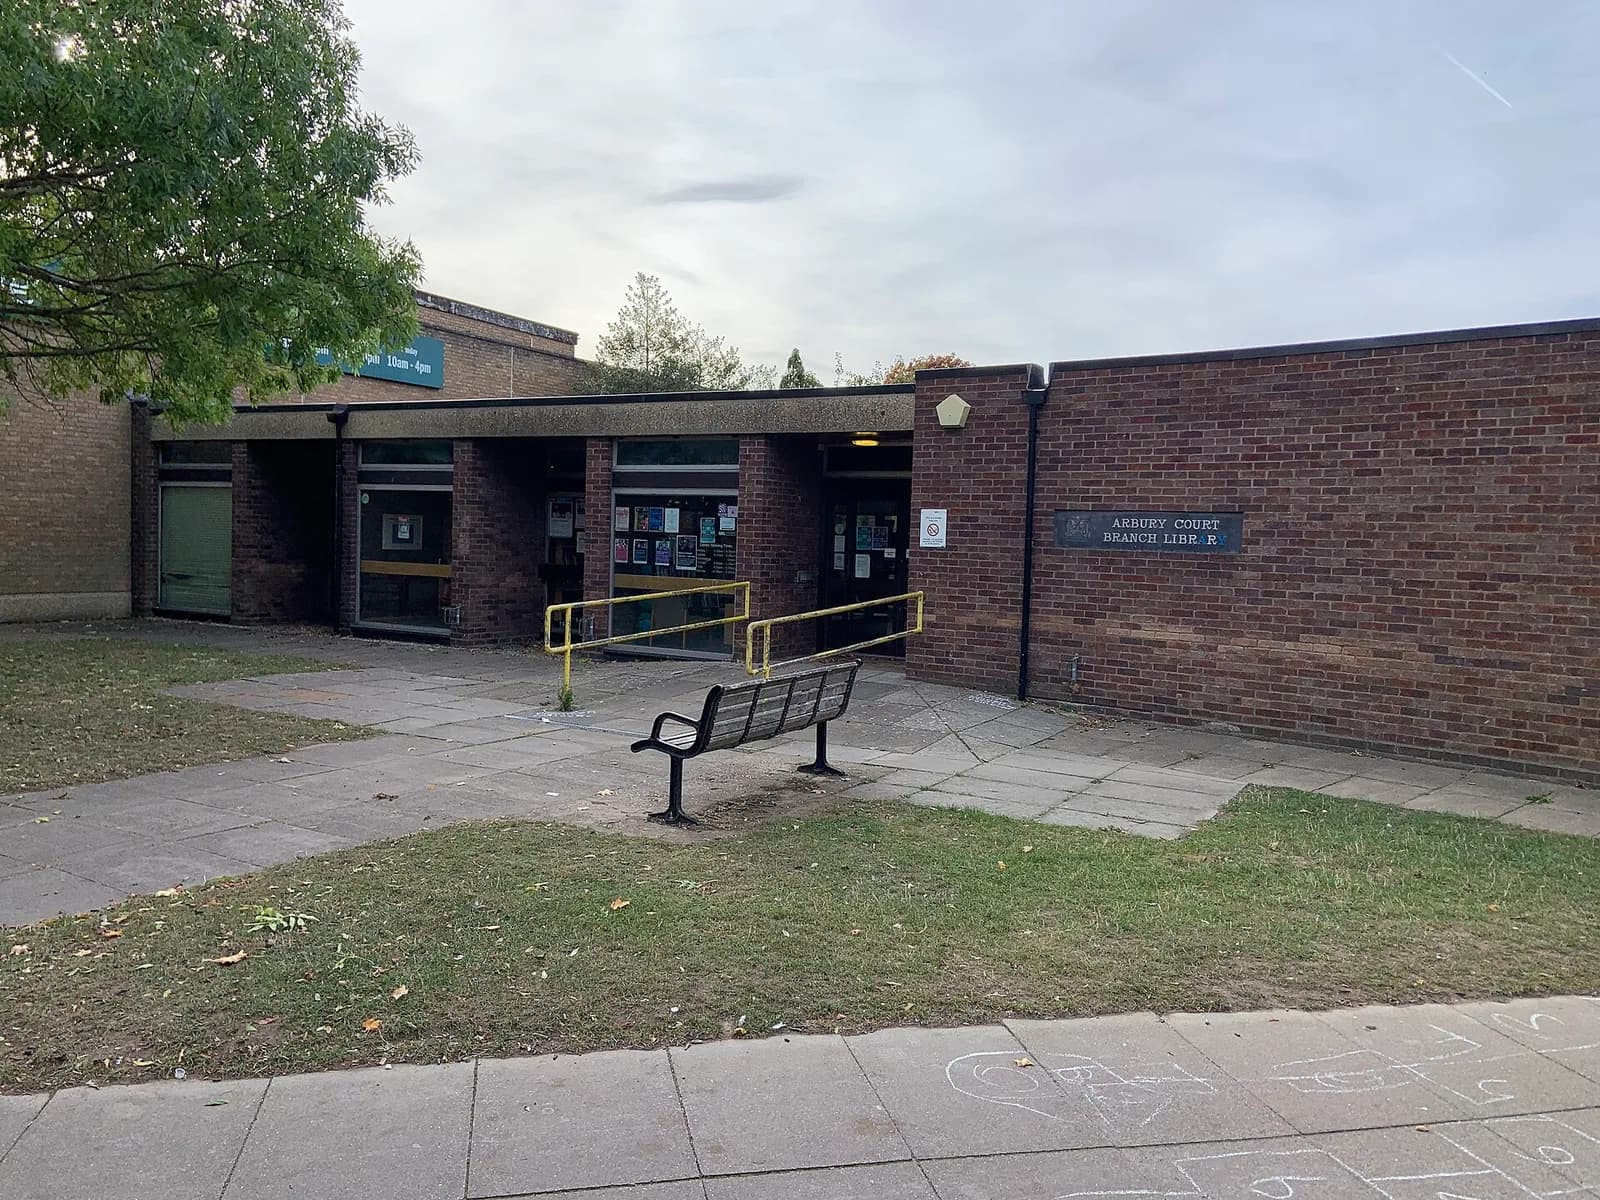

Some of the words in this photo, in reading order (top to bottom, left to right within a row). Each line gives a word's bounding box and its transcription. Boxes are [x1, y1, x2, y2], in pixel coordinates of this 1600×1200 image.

[386, 354, 409, 370] 10am
[414, 360, 432, 375] 4pm
[1111, 518, 1167, 530] ARBURY
[1174, 518, 1220, 531] COURT
[1103, 532, 1158, 544] BRANCH
